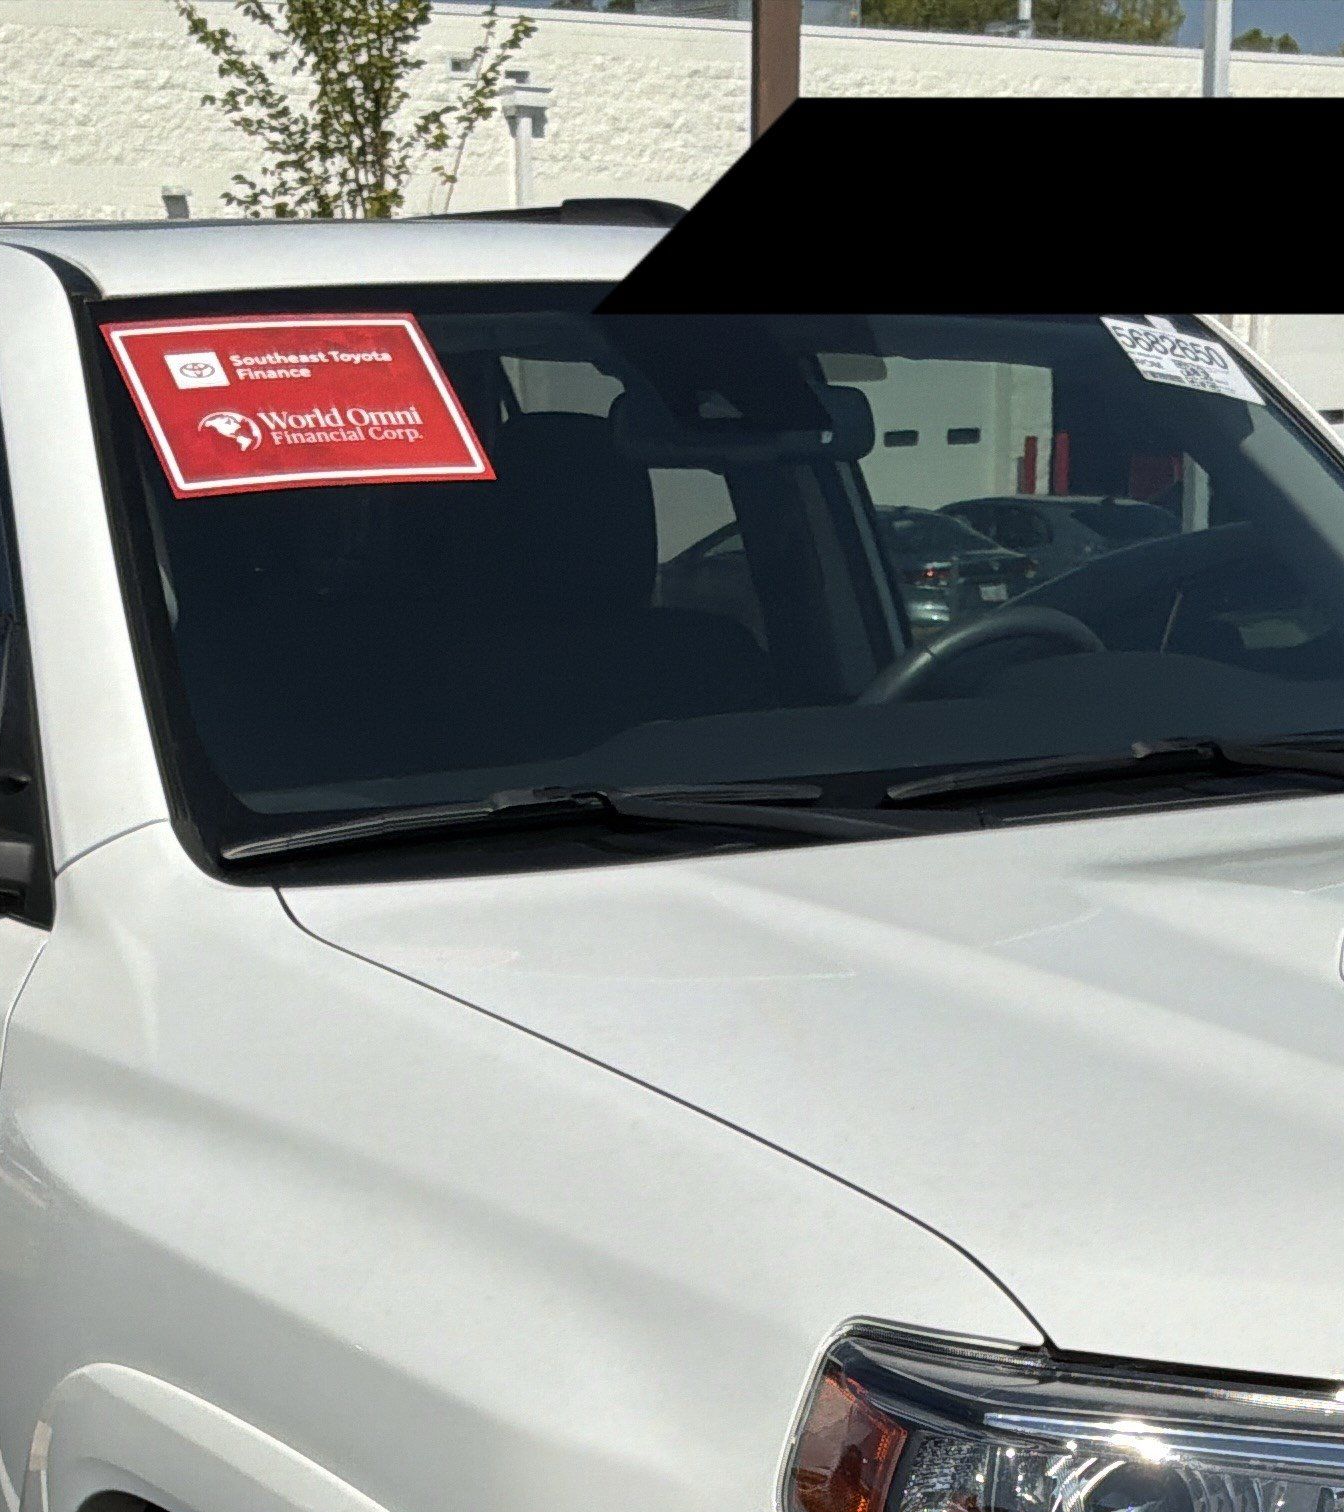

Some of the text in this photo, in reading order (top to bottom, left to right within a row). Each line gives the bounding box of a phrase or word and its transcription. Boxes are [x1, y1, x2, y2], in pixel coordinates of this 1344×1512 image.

[1111, 325, 1229, 370] 5682650
[229, 350, 392, 367] Southeast Toyota
[236, 366, 312, 381] Finance
[257, 406, 423, 430] World Omni
[272, 426, 424, 446] Financial Corp.
